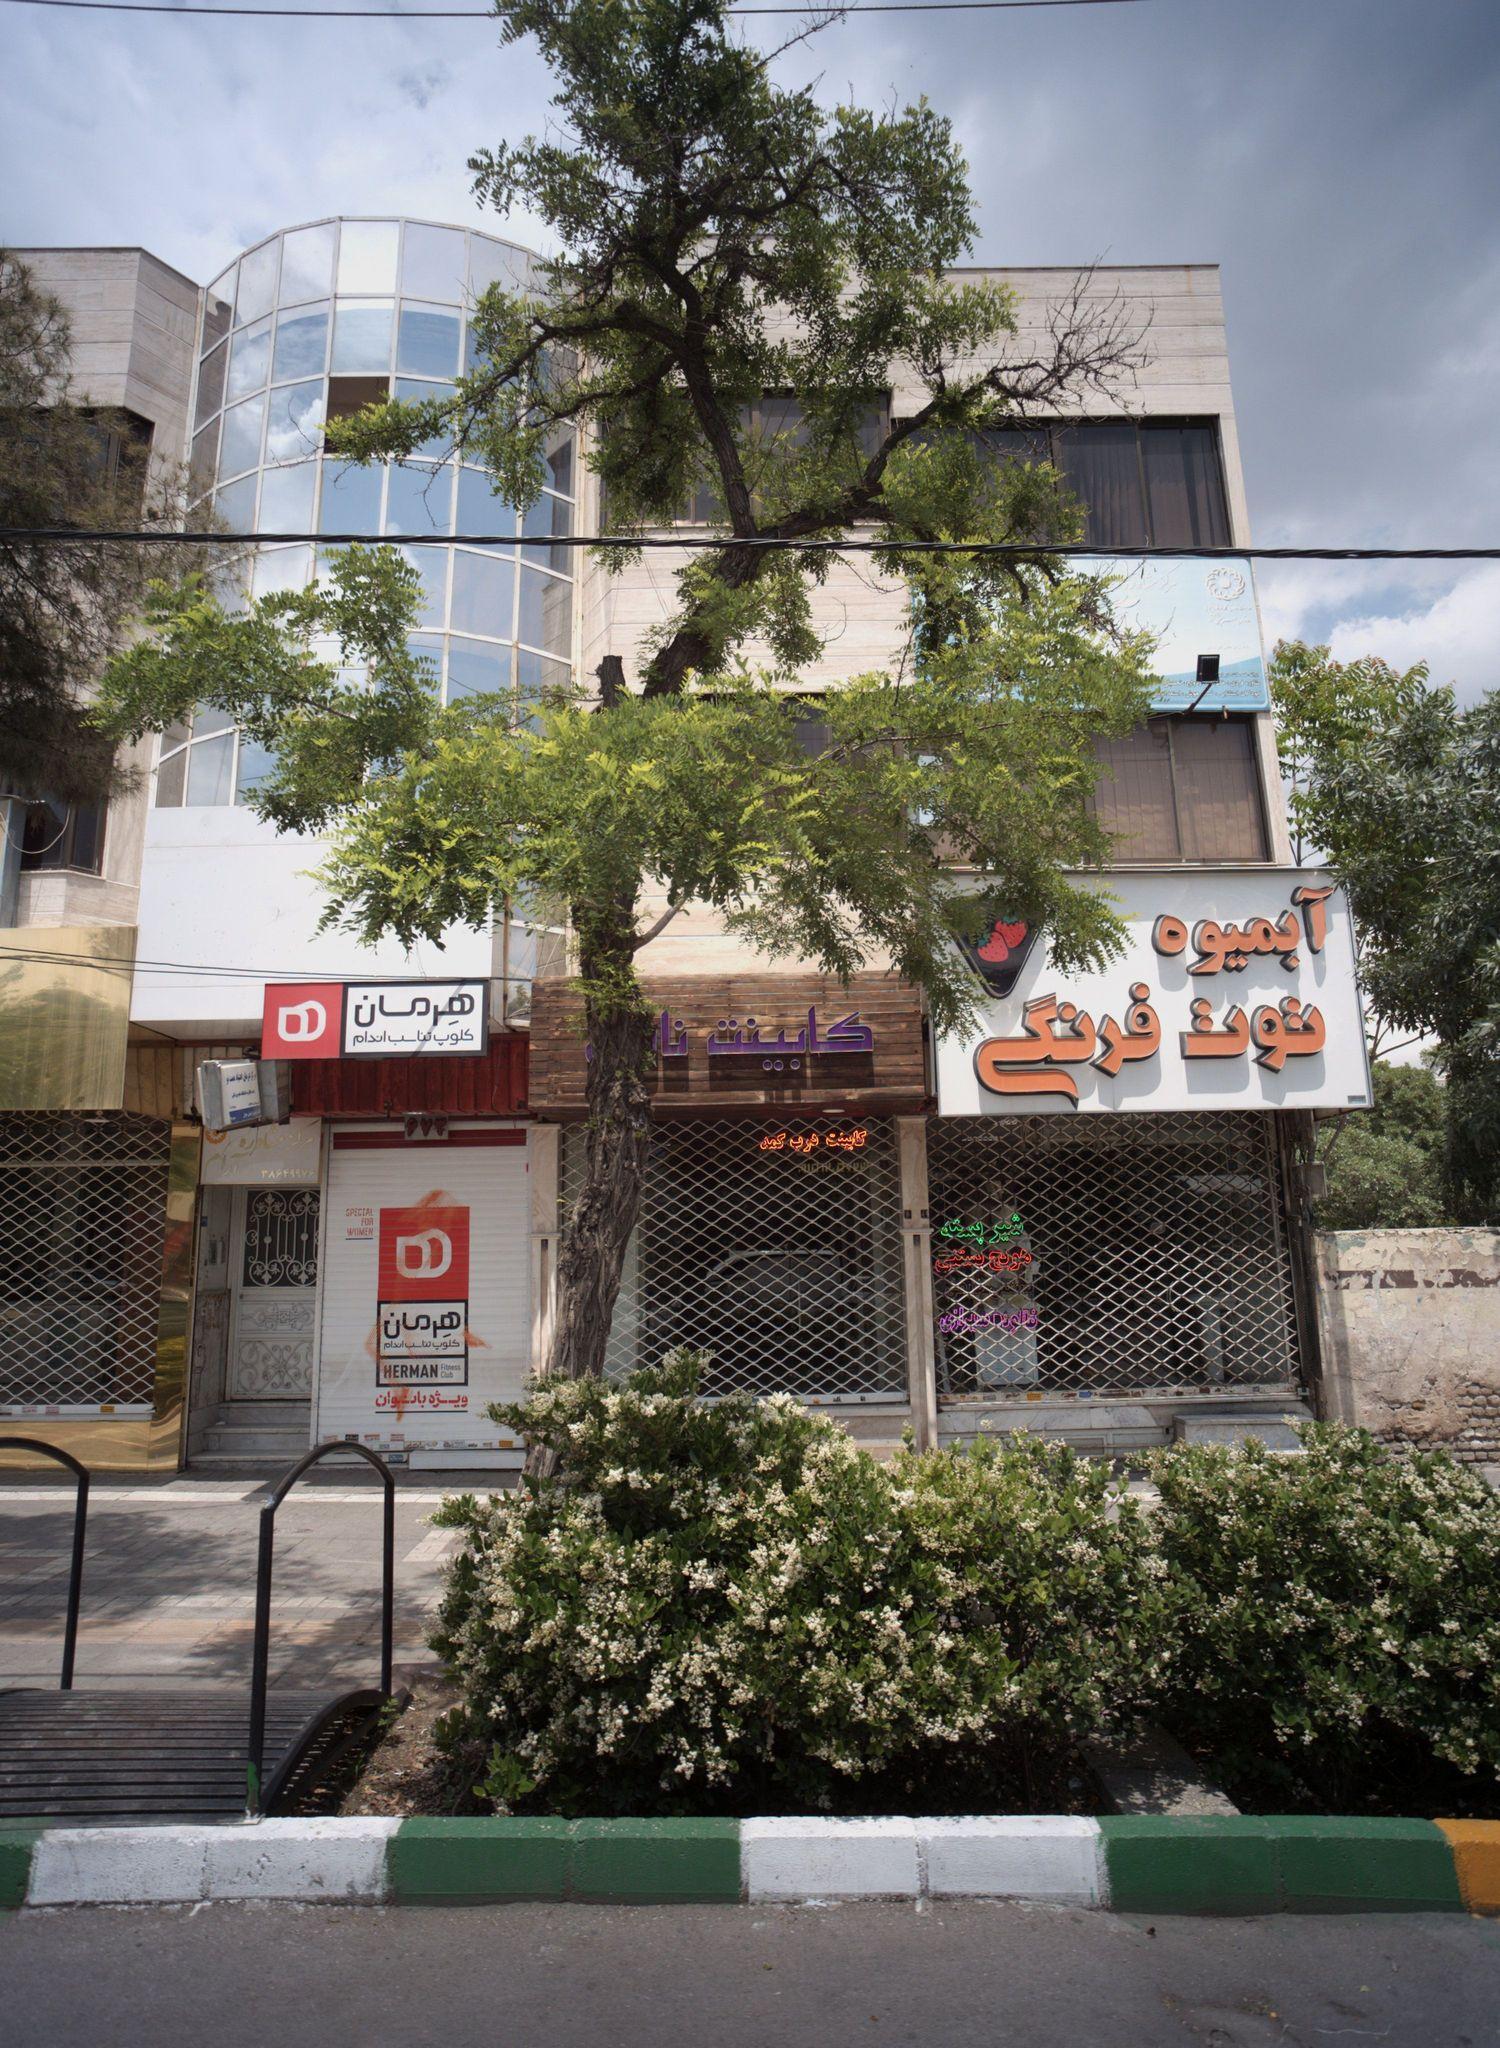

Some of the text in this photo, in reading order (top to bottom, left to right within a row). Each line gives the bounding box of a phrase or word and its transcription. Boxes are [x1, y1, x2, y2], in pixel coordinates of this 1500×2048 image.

[1151, 886, 1336, 976] آبمیوه
[352, 1028, 474, 1047] کلوپ تناسب اندام
[706, 1005, 875, 1071] کابینت
[973, 981, 1327, 1109] توت فرنگی
[826, 1129, 868, 1151] کابینت
[345, 1208, 374, 1217] SPECIAL
[360, 1218, 374, 1227] FOR
[346, 1227, 374, 1237] WOMEN
[383, 1339, 460, 1351] کلوپ تناسب اندام
[383, 1363, 462, 1379] HERMAN Fitness
[440, 1371, 454, 1379] Club
[375, 1390, 469, 1409] ویژه بانوان
